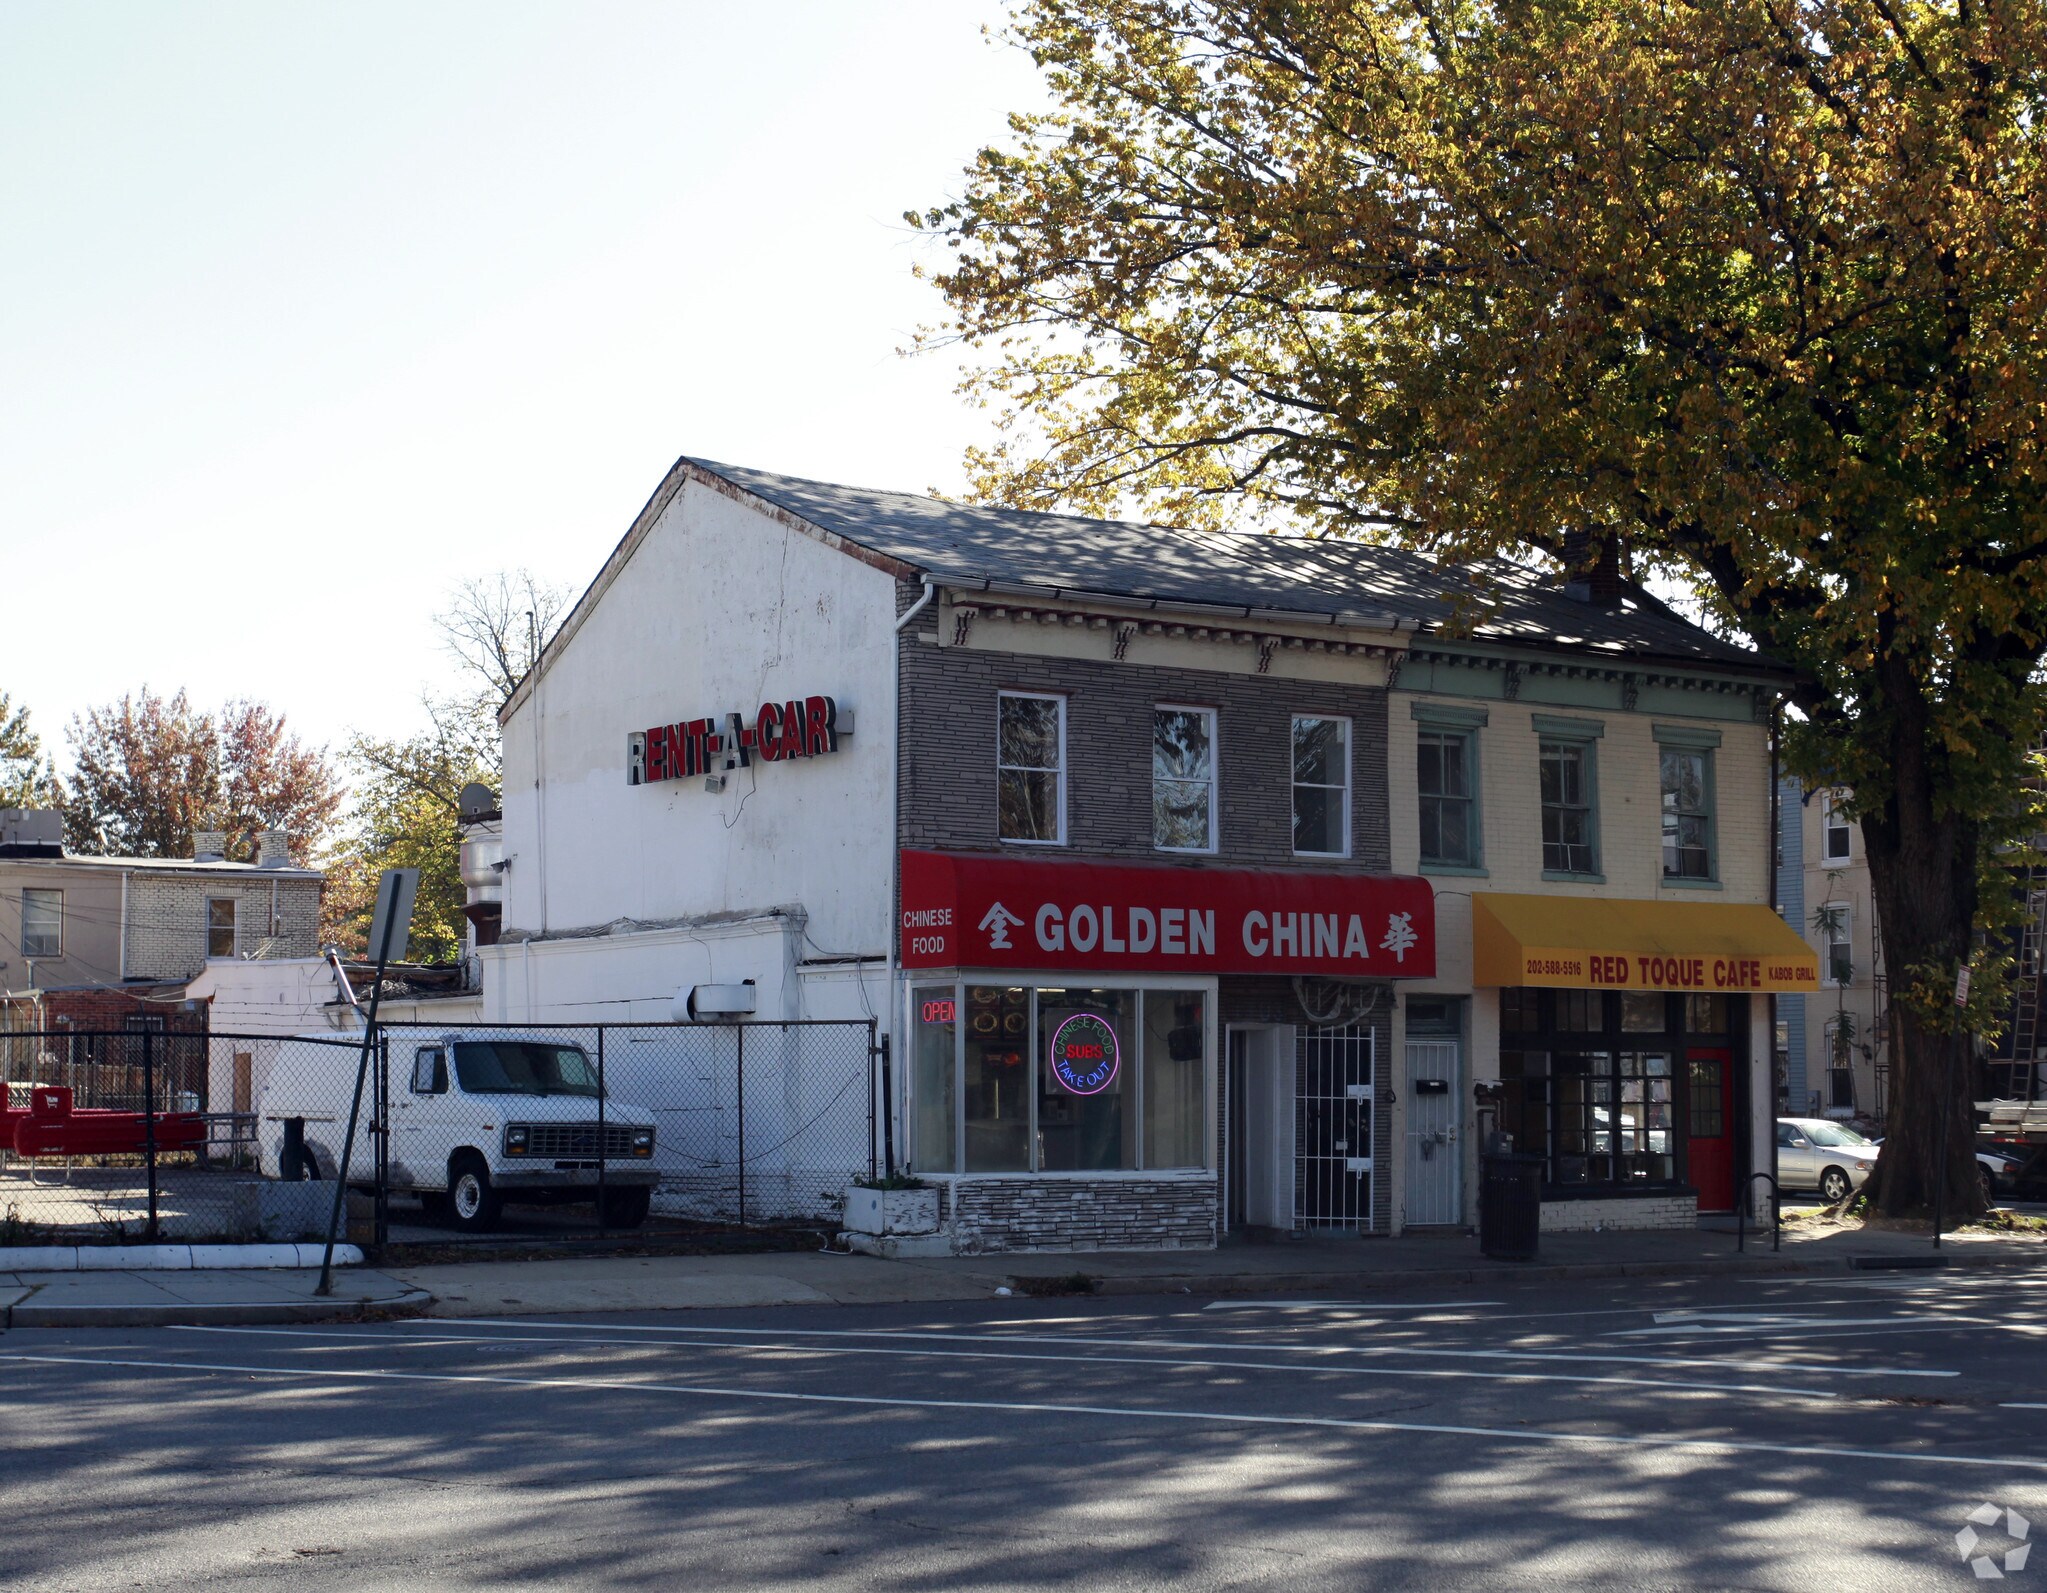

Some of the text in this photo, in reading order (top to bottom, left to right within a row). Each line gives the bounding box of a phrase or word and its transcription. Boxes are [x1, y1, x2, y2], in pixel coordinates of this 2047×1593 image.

[627, 696, 838, 785] RENT-A-CAR
[903, 908, 952, 928] CHINESE
[976, 901, 1025, 949] 金
[1035, 903, 1369, 958] GOLDEN CHINA
[912, 936, 945, 954] FOOD
[1379, 911, 1418, 963] 華
[1589, 956, 1629, 984] RED
[1638, 957, 1704, 986] TOQUE
[1714, 960, 1761, 987] CAFE
[1768, 966, 1793, 981] KABOB
[1796, 967, 1816, 981] GRILL
[923, 1001, 956, 1022] OPEN
[1055, 1016, 1115, 1055] CHINESE FOOD
[1065, 1044, 1103, 1059] SUBS
[1057, 1059, 1110, 1088] TAKE OUT
